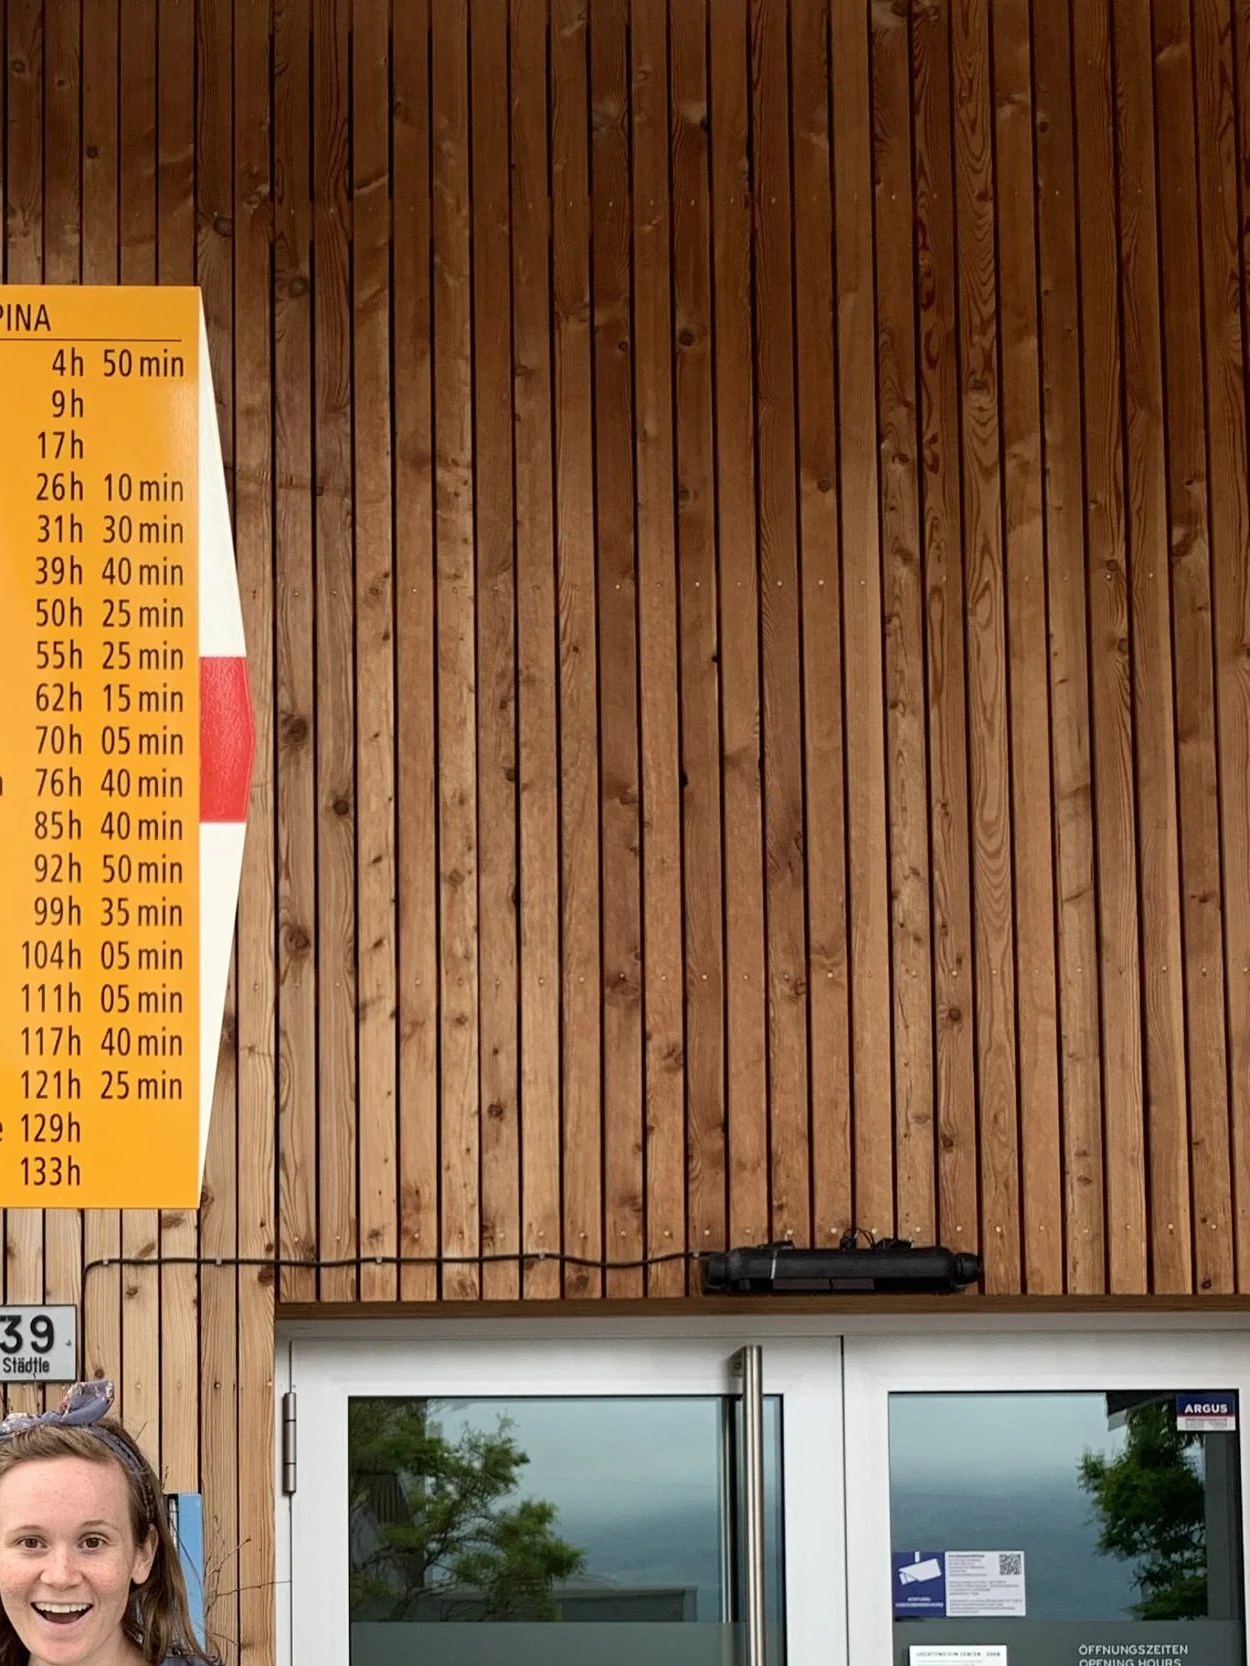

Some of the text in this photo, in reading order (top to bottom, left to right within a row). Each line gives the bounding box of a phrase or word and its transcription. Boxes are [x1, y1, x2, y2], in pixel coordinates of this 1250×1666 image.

[103, 348, 133, 378] 50
[139, 348, 184, 378] min
[104, 472, 133, 502] 10
[139, 472, 184, 502] min
[102, 514, 133, 544] 30
[139, 514, 184, 544] min
[101, 556, 132, 586] 40
[139, 556, 184, 586] min
[102, 598, 131, 628] 25
[139, 597, 184, 628] min
[102, 640, 131, 670] 25
[139, 640, 184, 671] min
[103, 683, 131, 713] 15
[138, 682, 184, 713] min
[101, 725, 131, 756] 05
[138, 725, 184, 756] min
[100, 768, 131, 798] 40
[138, 767, 183, 798] min
[100, 811, 131, 841] 40
[138, 810, 183, 841] min
[102, 853, 132, 884] 50
[138, 853, 183, 884] min
[100, 896, 130, 927] 35
[137, 896, 183, 927] min
[100, 940, 130, 970] 05
[138, 940, 183, 971] min
[100, 983, 130, 1014] 05
[138, 983, 183, 1014] min
[100, 1027, 131, 1057] 40
[137, 1026, 183, 1057] min
[100, 1070, 130, 1100] 25
[137, 1069, 183, 1100] min
[2, 1356, 50, 1374] Städtle
[1184, 1403, 1228, 1414] ARGUS
[1078, 1644, 1188, 1655] ÖFFNUNGSZEITEN
